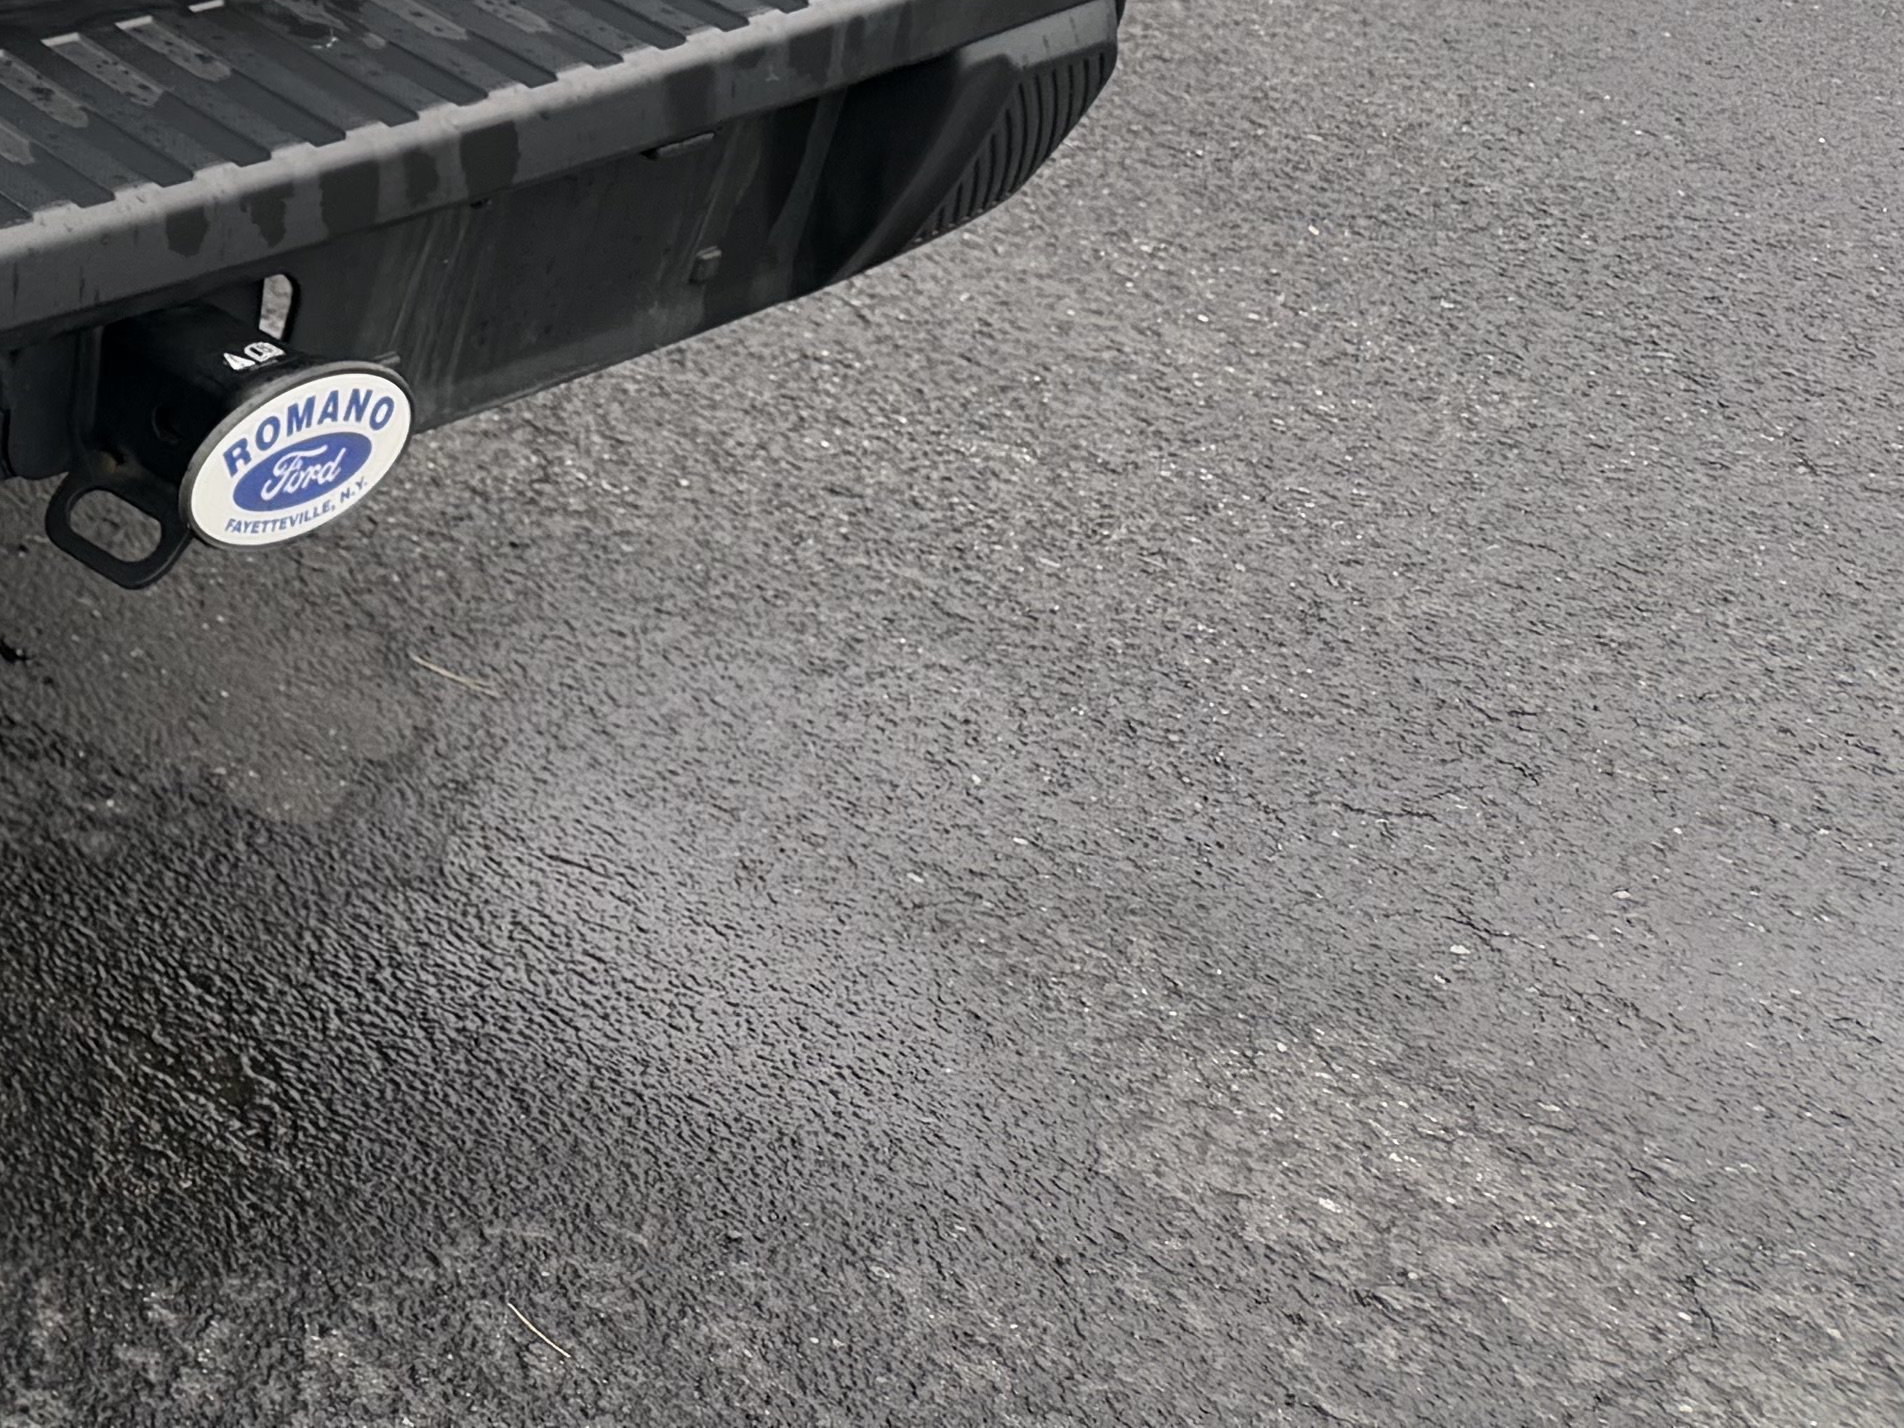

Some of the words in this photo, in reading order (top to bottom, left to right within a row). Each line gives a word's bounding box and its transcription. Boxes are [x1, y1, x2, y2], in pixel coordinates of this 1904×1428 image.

[222, 388, 395, 478] ROMANO
[260, 444, 346, 501] Ford
[224, 498, 337, 535] FAYETTEVILLE,
[340, 476, 369, 503] N.Y.
